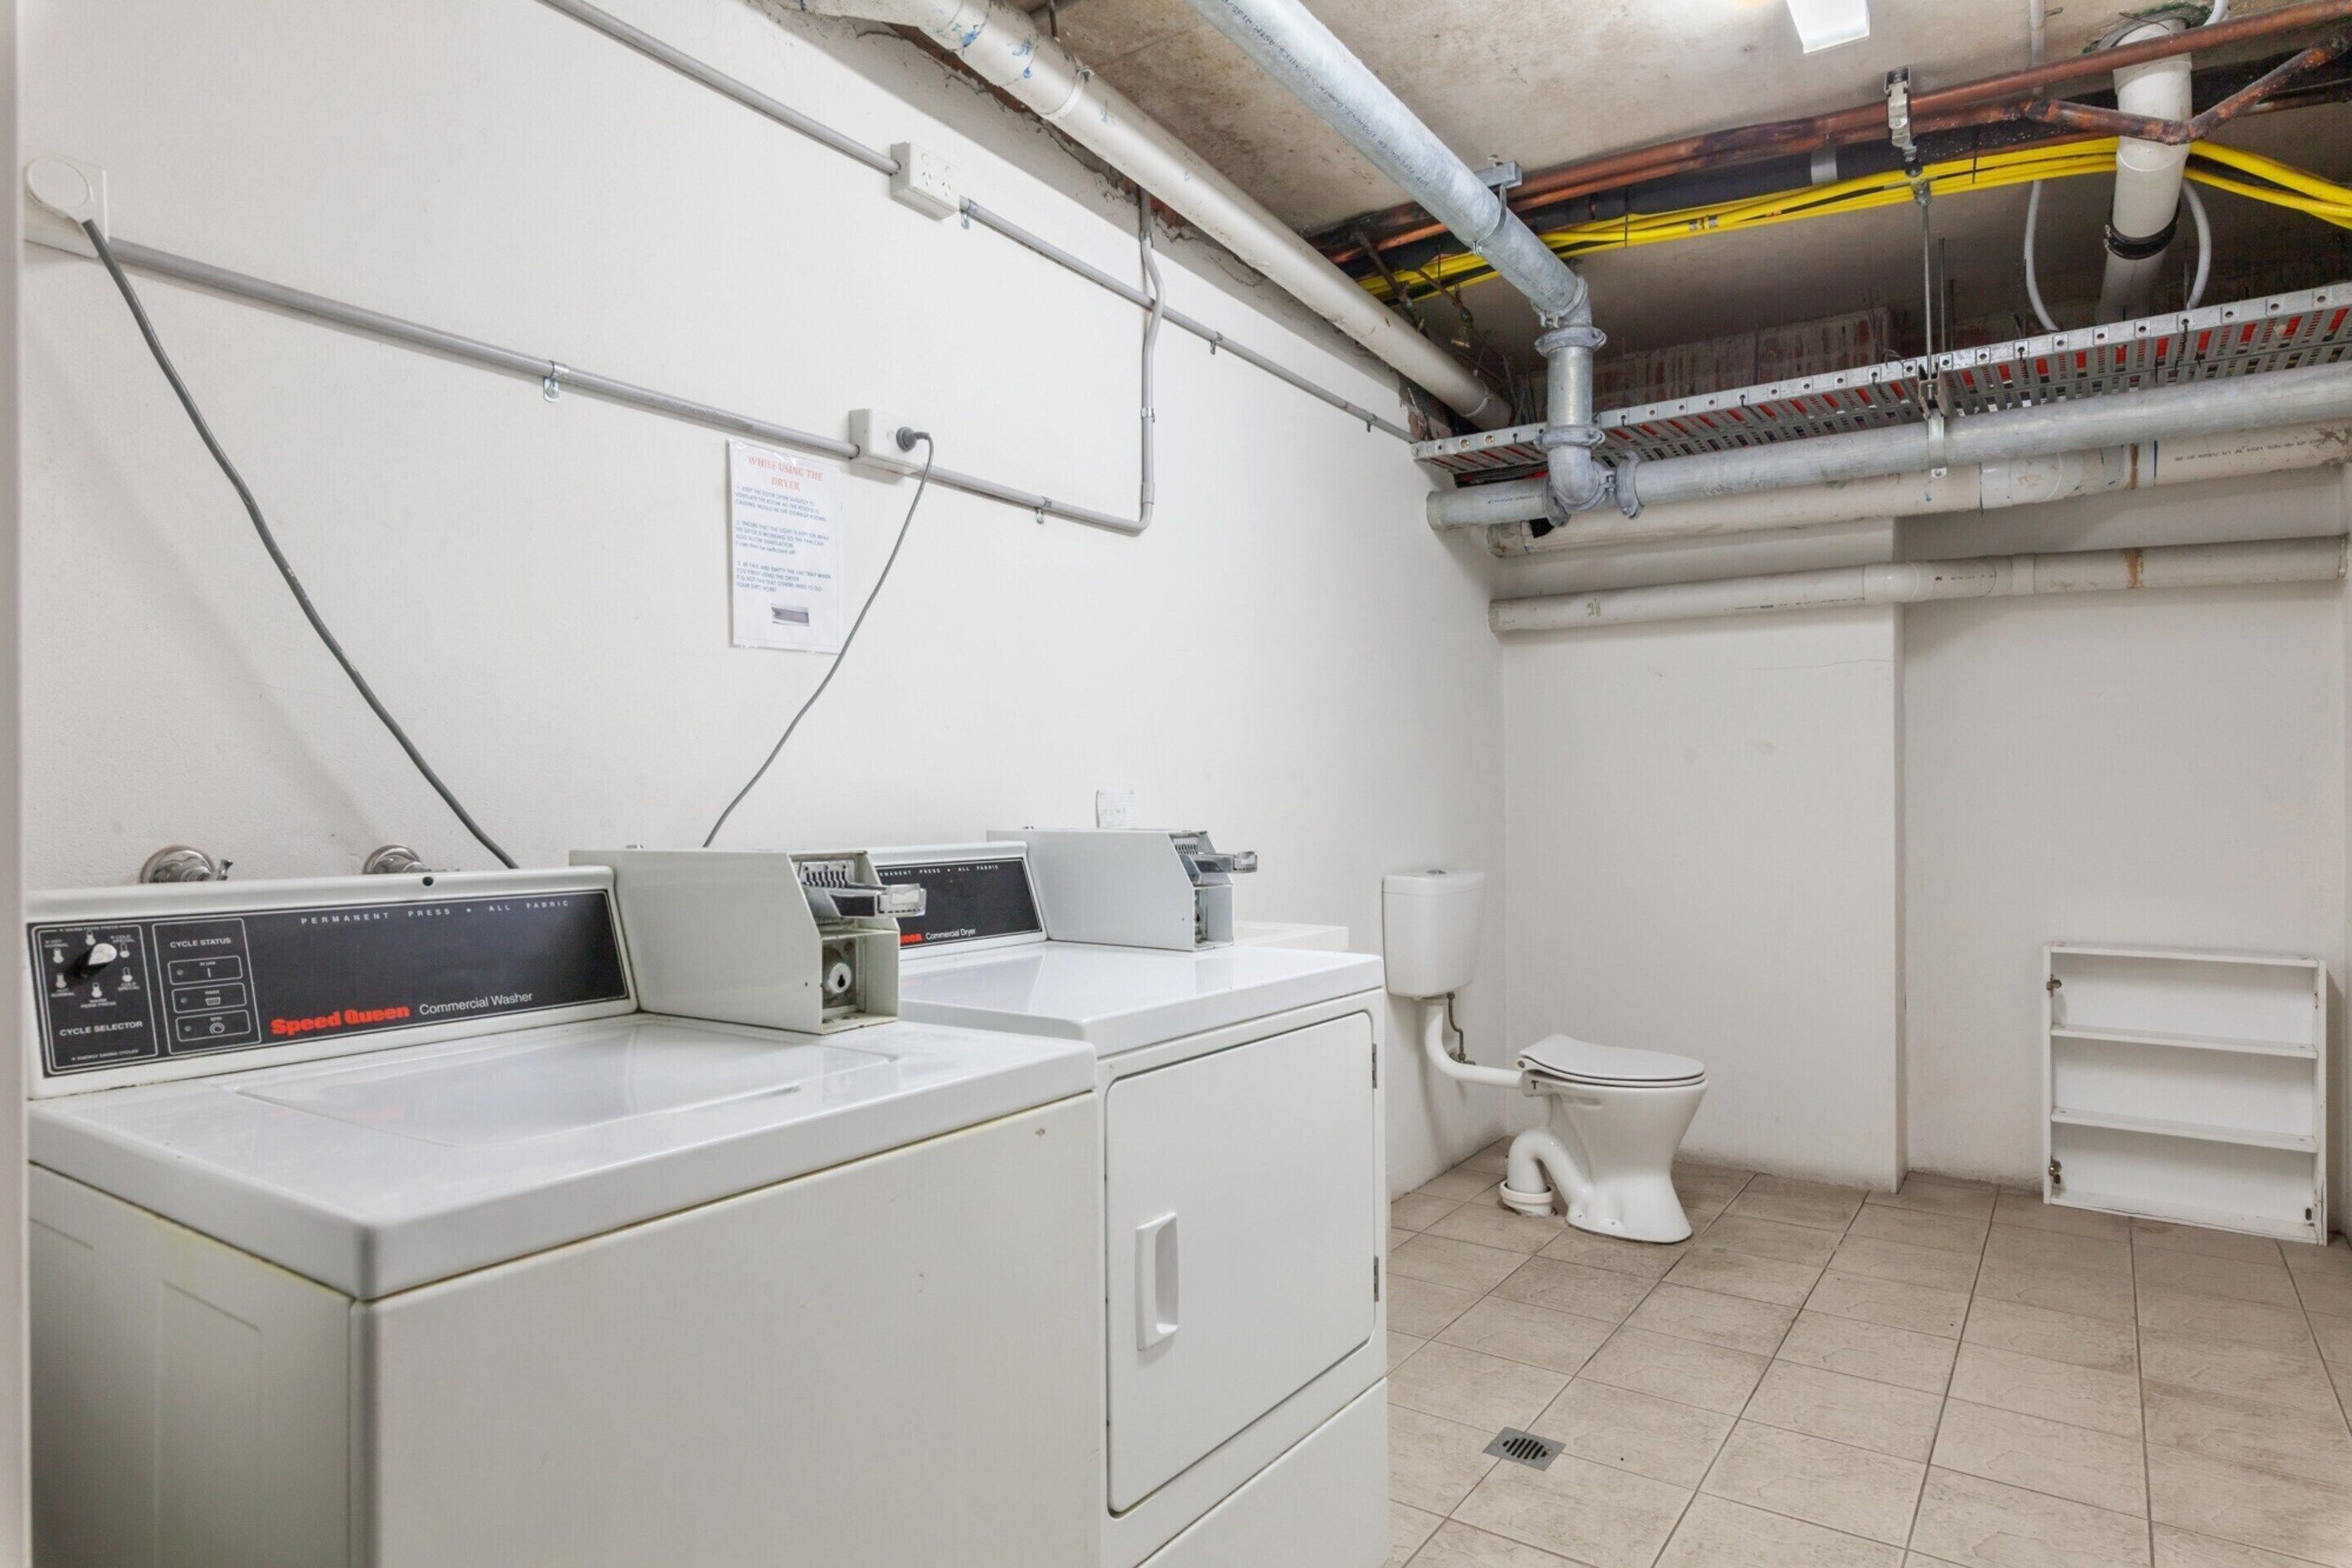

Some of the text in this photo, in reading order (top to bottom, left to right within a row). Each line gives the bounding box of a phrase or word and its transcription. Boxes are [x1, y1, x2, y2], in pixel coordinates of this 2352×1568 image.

[749, 456, 823, 481] WHILE USING THE
[771, 476, 800, 491] DRYER
[301, 900, 569, 925] PERMANENT PRESS ALL FABRIC
[170, 937, 232, 949] CYCLE STATUS
[925, 928, 976, 941] Commercial Dryer
[419, 992, 533, 1016] Commercial Washer
[60, 1021, 143, 1037] CYCLE SELECTOR
[270, 1005, 410, 1036] Speed Queen
